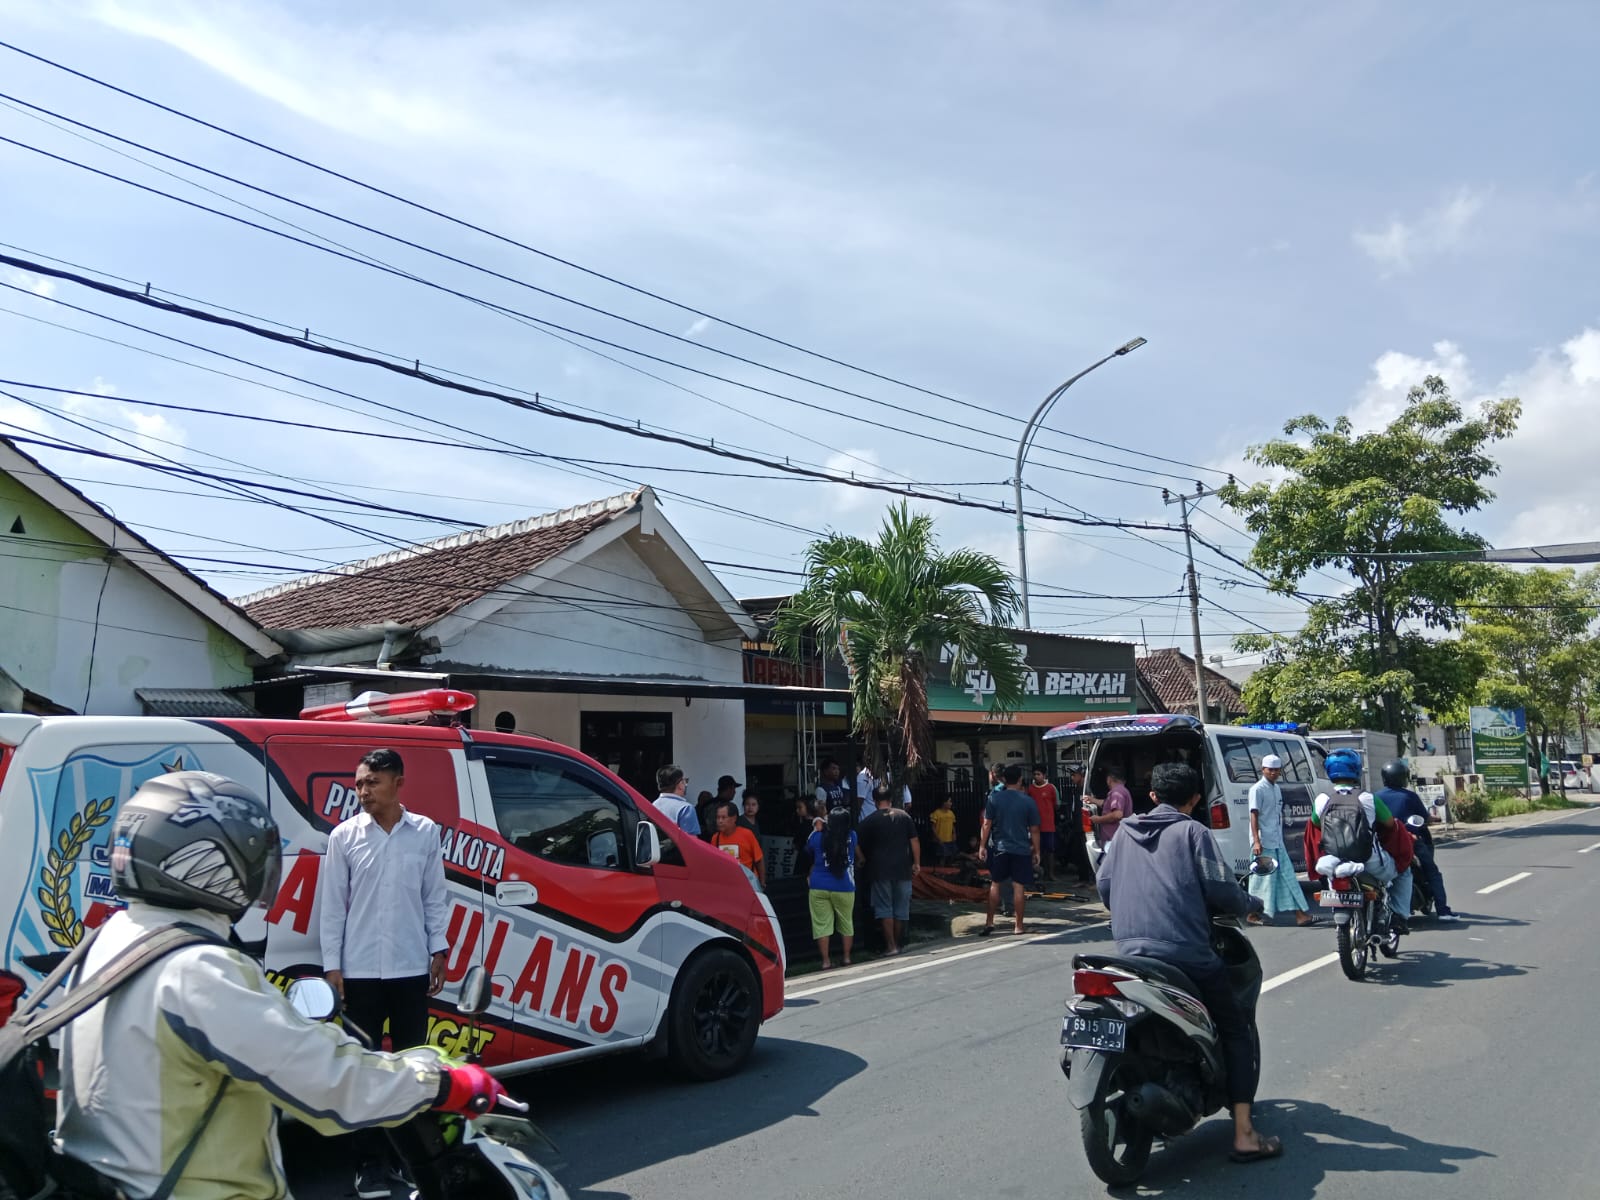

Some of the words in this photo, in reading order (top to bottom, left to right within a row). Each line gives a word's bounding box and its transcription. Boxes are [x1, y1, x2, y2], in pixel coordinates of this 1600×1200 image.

[1045, 673, 1126, 695] BERKAH
[264, 848, 627, 1034] AULANS
[1074, 1018, 1099, 1033] 6915
[1108, 1021, 1123, 1035] DY
